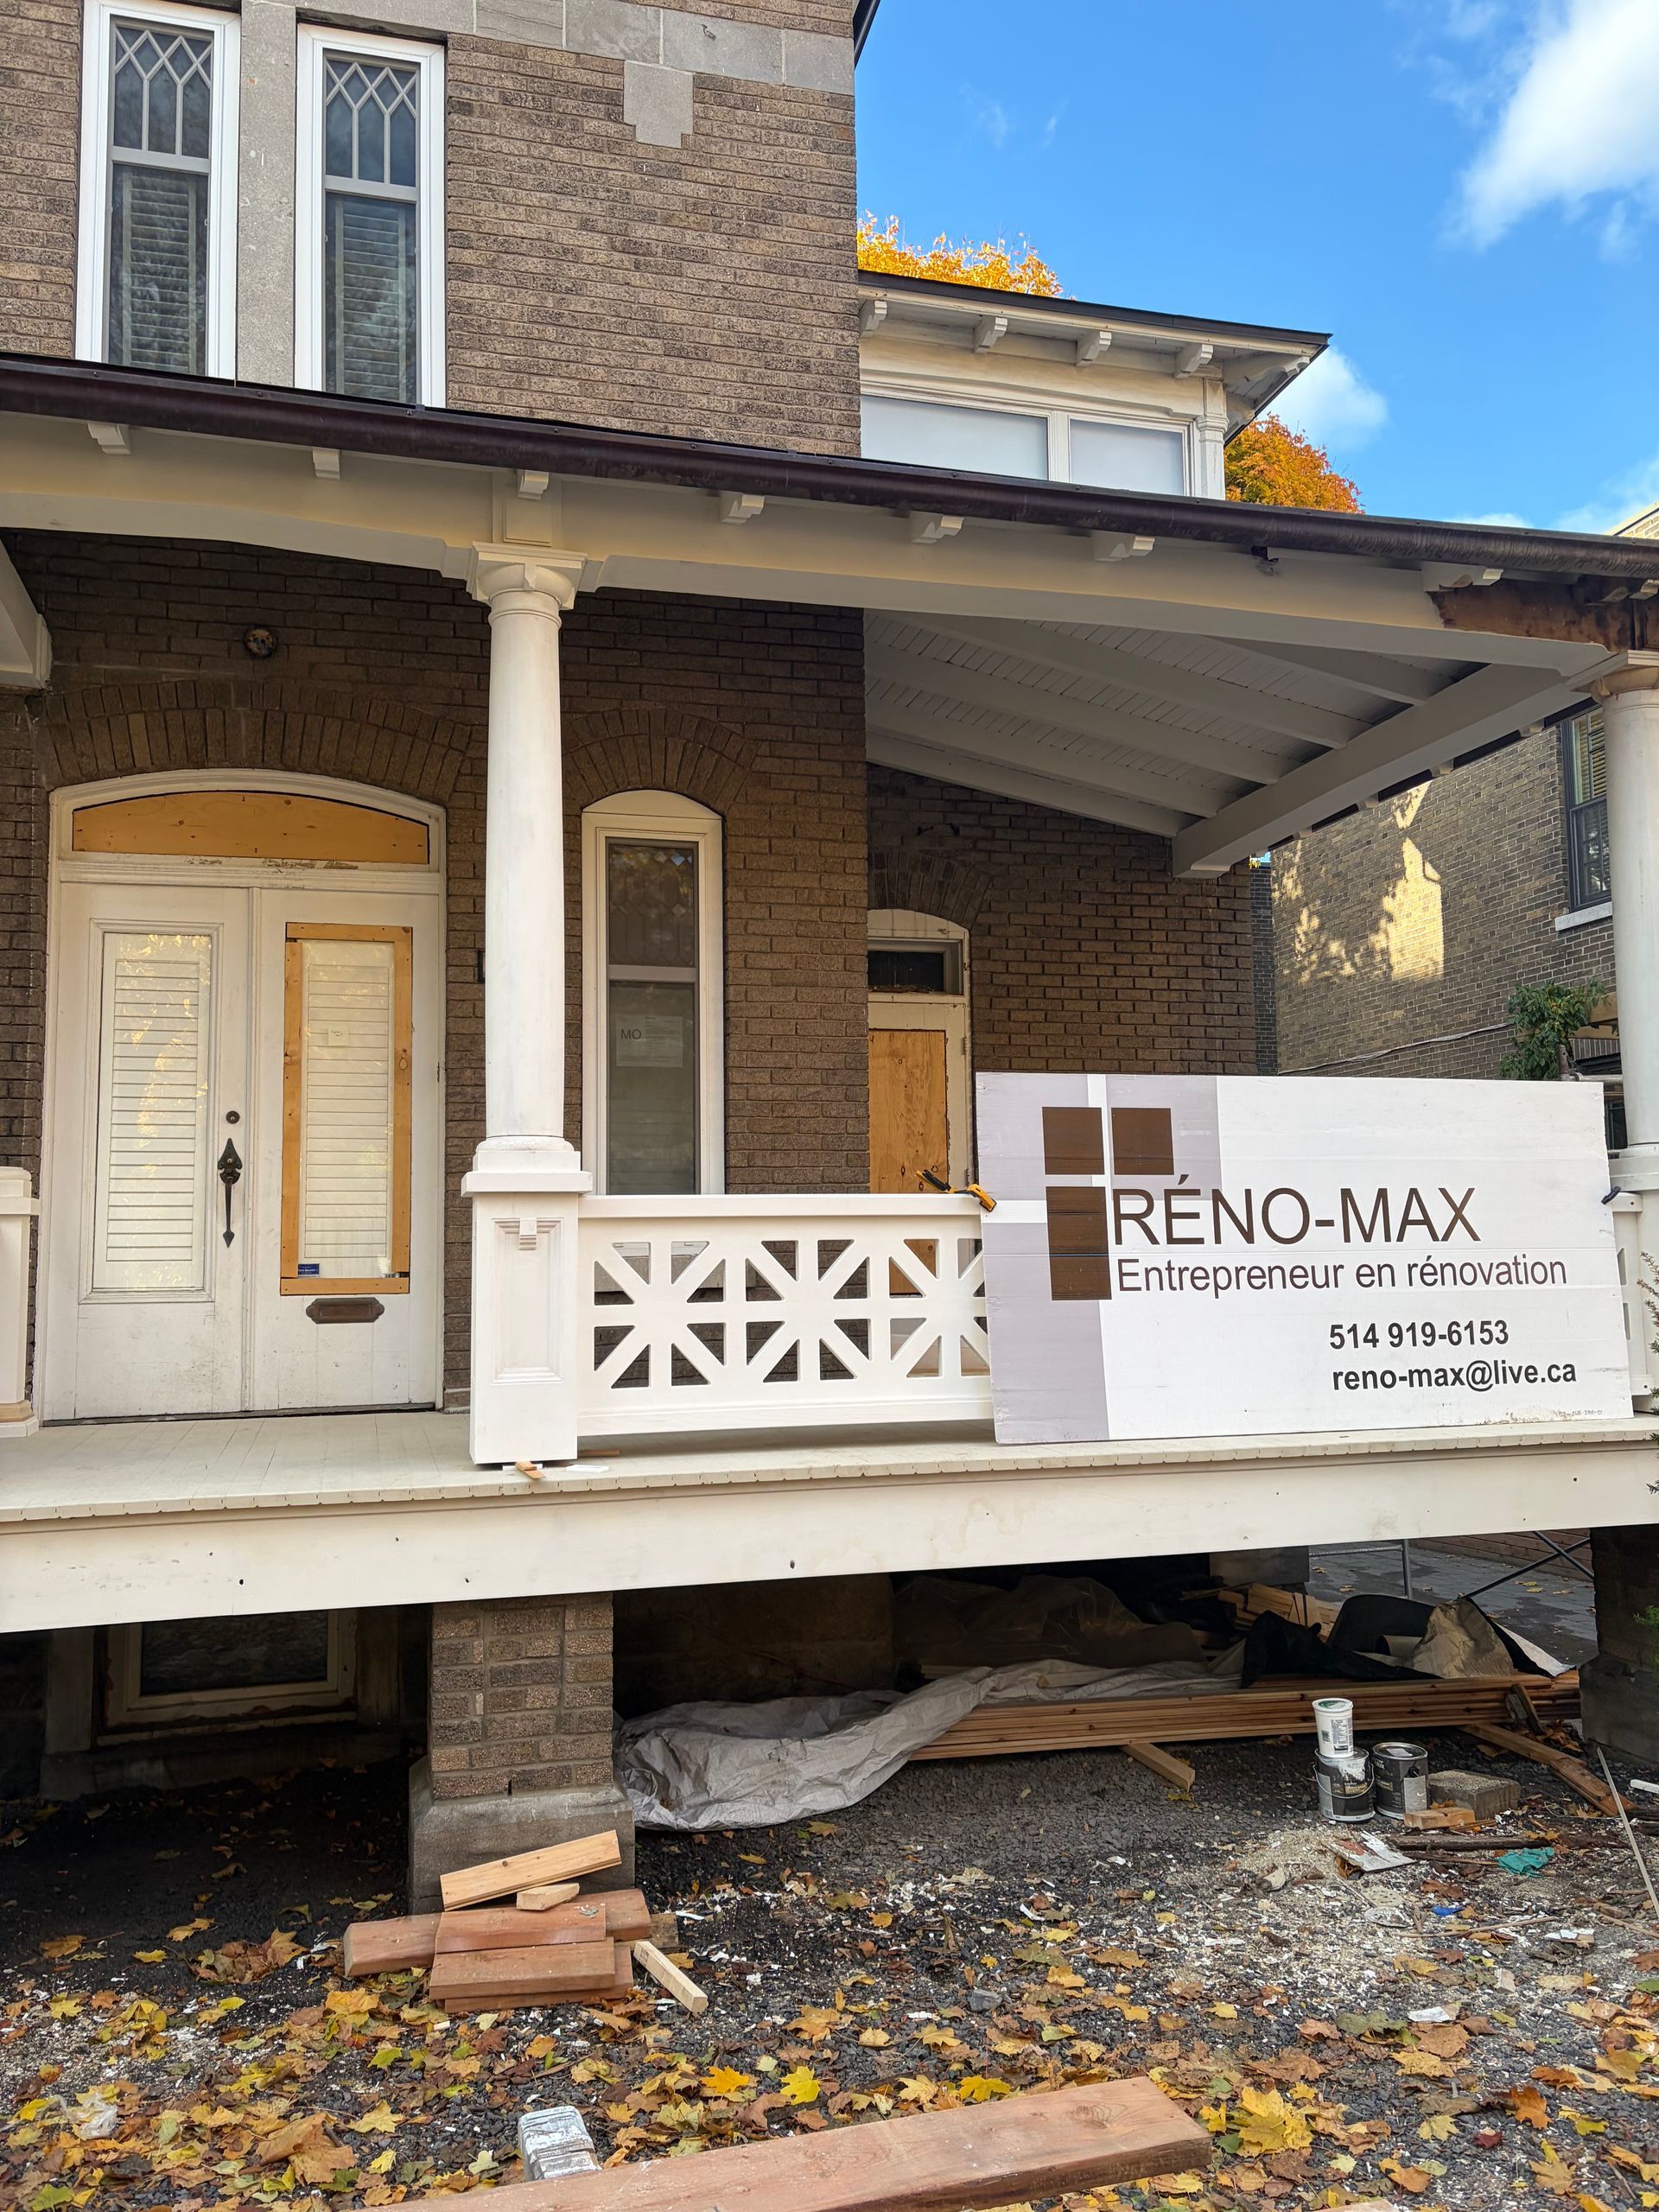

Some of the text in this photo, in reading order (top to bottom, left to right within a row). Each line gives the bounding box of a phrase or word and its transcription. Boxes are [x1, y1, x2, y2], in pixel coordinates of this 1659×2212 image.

[620, 1029, 642, 1040] MO
[1113, 1174, 1481, 1246] RÉNO-MAX
[1118, 1254, 1567, 1299] Entrepreneur en rénovation
[1330, 1320, 1510, 1350] 514 919-6153
[1332, 1360, 1577, 1393] reno-max@live.ca
